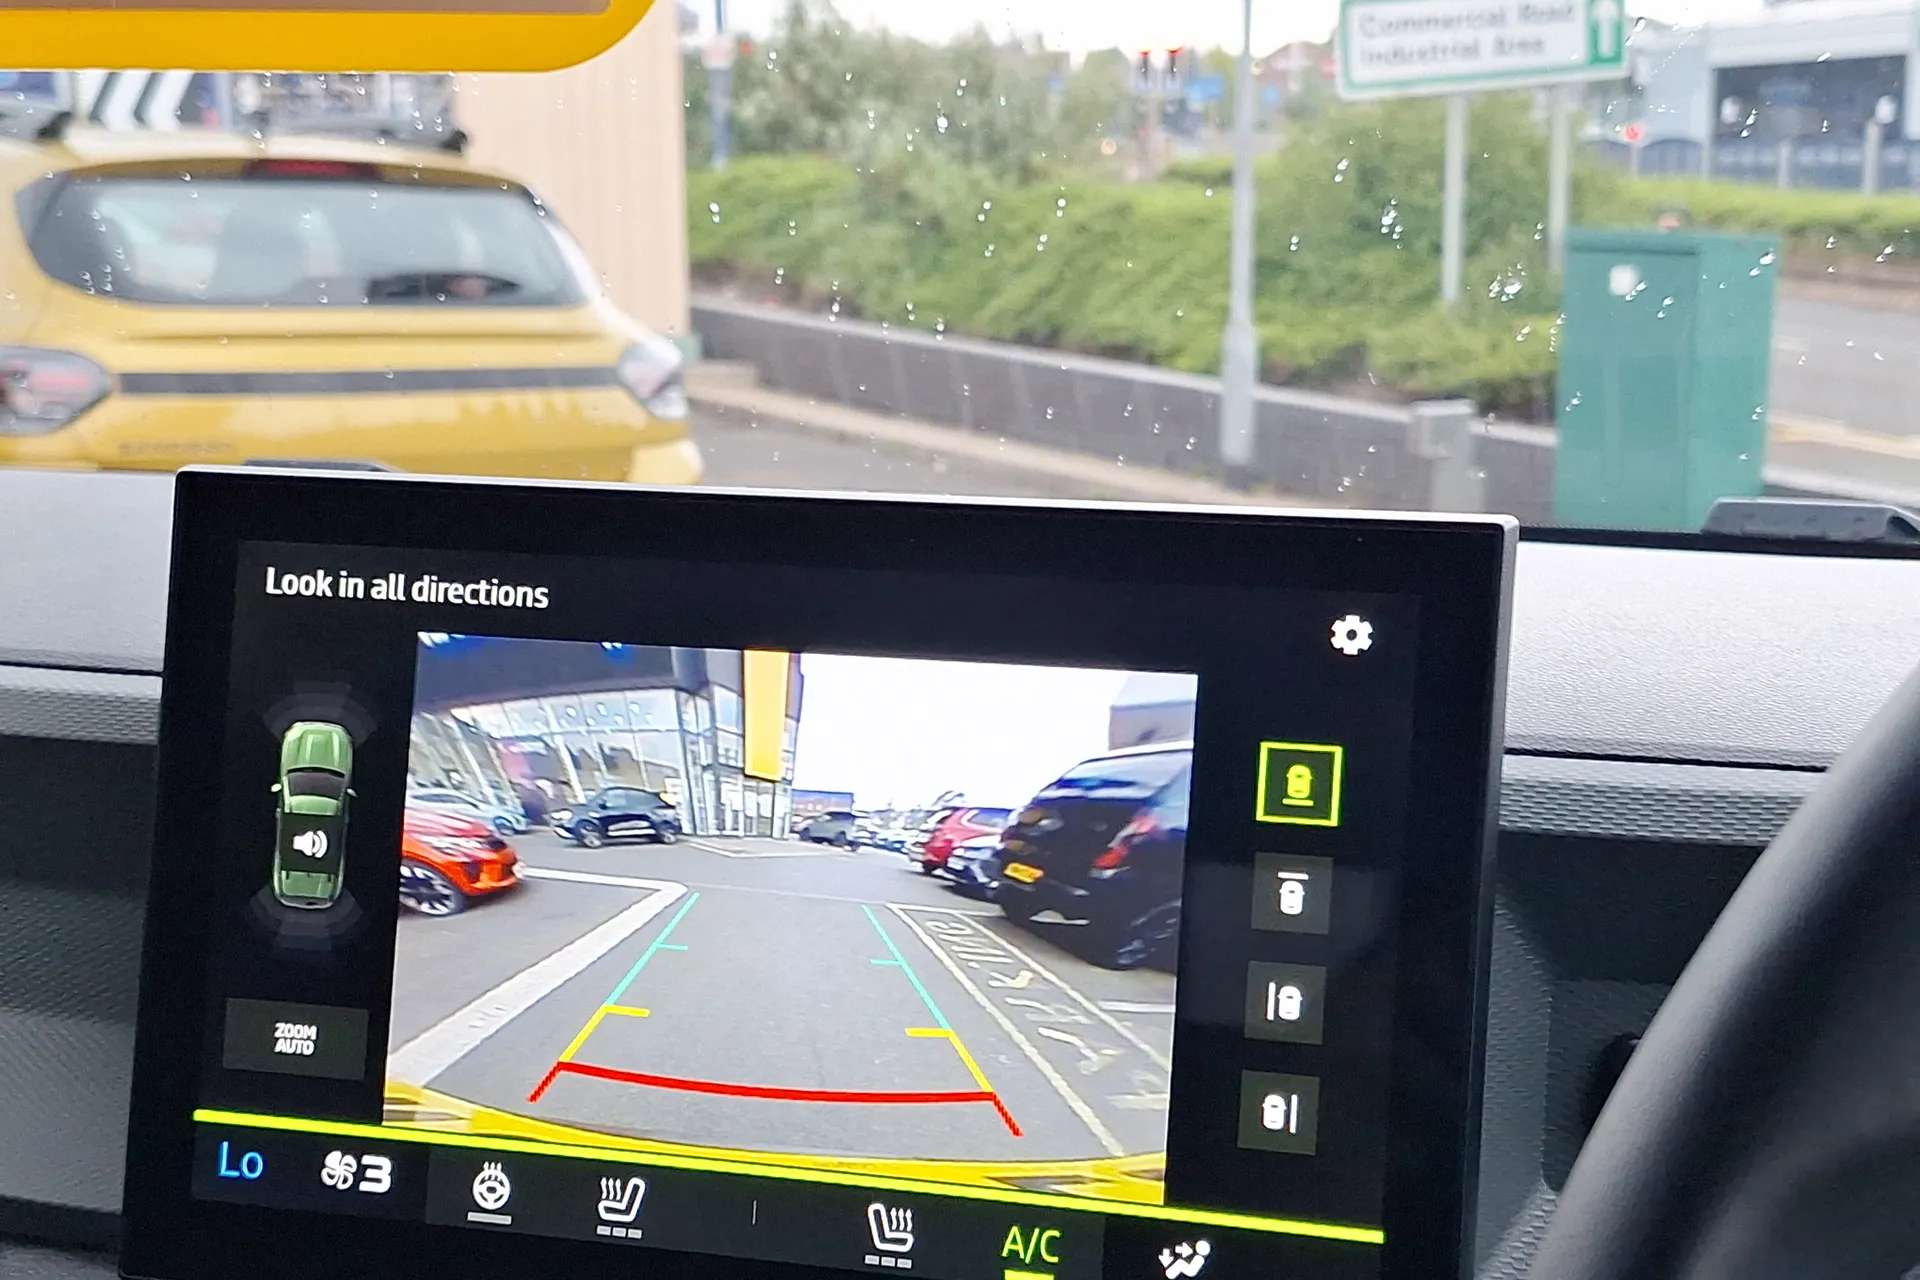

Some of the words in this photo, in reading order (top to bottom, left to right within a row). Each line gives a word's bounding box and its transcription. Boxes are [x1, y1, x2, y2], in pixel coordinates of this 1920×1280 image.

[1360, 8, 1506, 37] Commercial
[1361, 39, 1480, 64] Industrial
[265, 566, 333, 597] Look
[338, 570, 364, 599] in
[370, 573, 406, 601] all
[411, 575, 549, 608] directions
[274, 1022, 317, 1040] ZOOM
[274, 1039, 314, 1056] AUTO
[218, 1141, 264, 1179] Lo
[358, 1154, 392, 1194] 3
[1002, 1225, 1061, 1264] A/C
